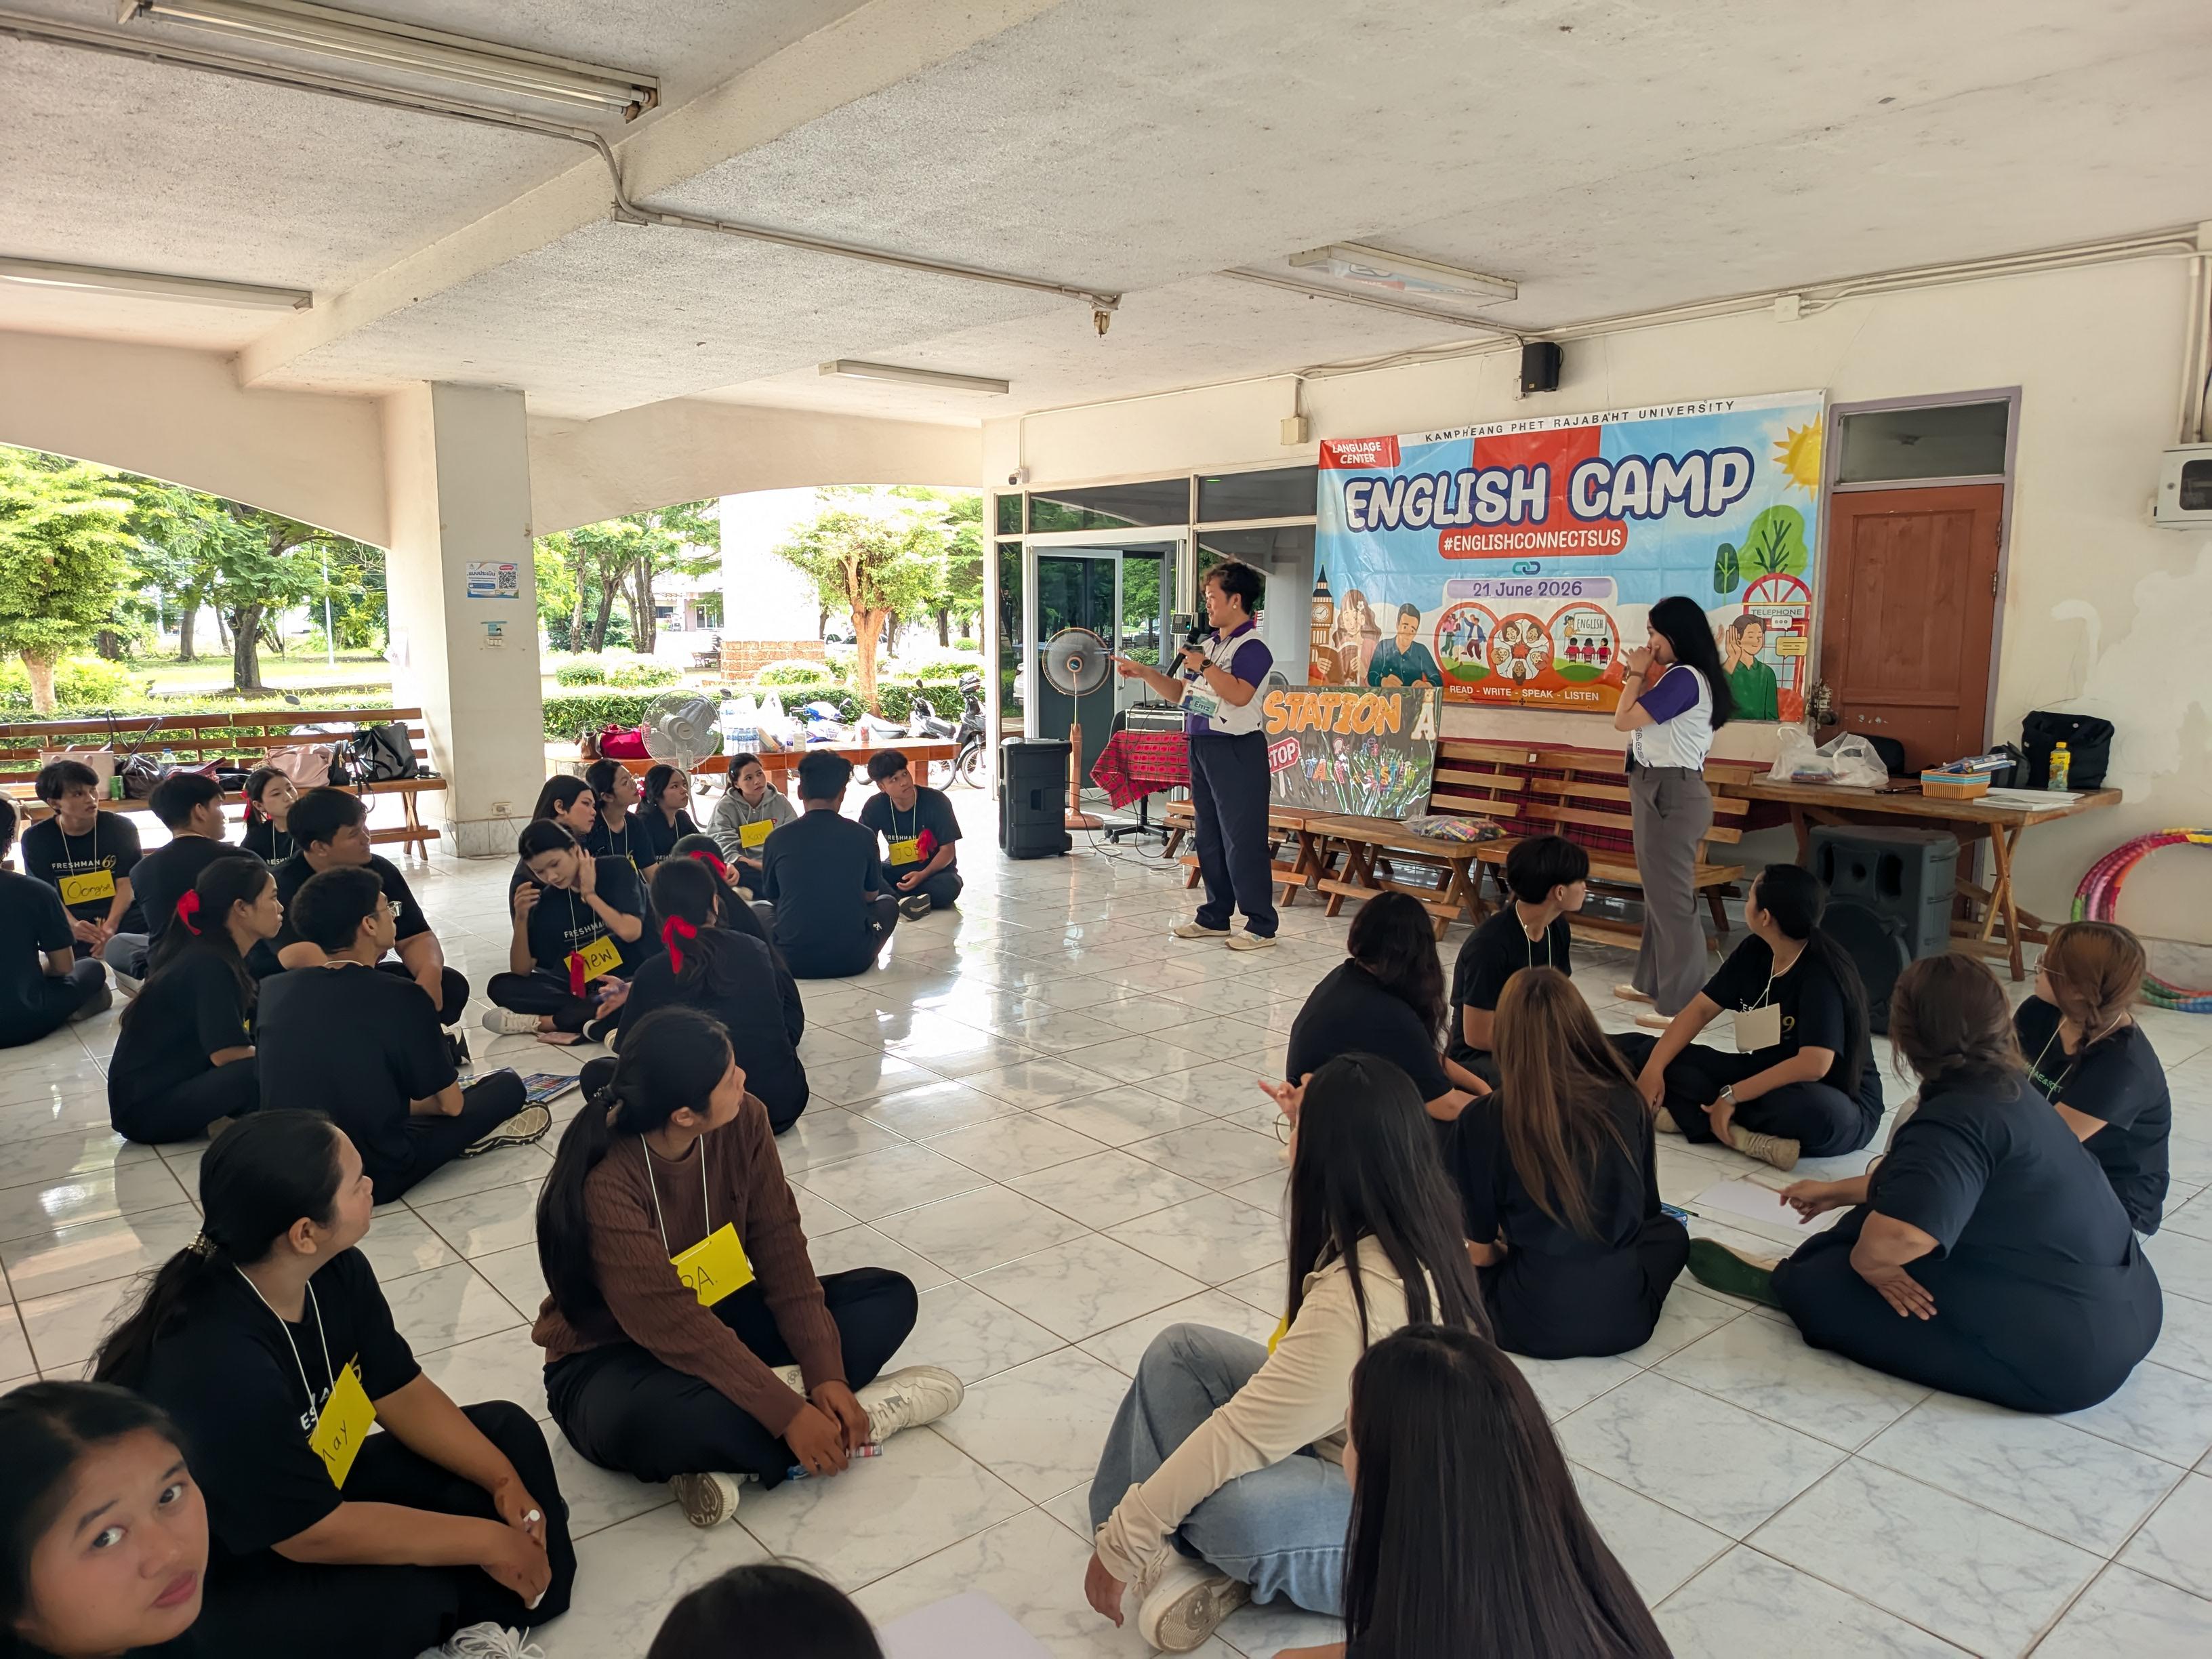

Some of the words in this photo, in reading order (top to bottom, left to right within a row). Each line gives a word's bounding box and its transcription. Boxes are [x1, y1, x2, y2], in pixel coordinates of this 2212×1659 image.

[1425, 425, 1503, 443] KAMPHEANG
[1511, 420, 1544, 432] PHET
[1553, 411, 1629, 428] RAJABAHT
[1639, 401, 1734, 419] UNIVERSITY
[1332, 441, 1382, 453] LANGUAGE
[1340, 453, 1376, 464] CENTER
[1345, 466, 1548, 530] ENGLISH
[1570, 451, 1751, 518] CAMP
[1443, 529, 1622, 552] #ENGLISHCONNECTSUS
[1473, 583, 1490, 597] 21
[1495, 582, 1533, 596] June
[1538, 581, 1582, 596] 2026
[1576, 619, 1603, 629] ENGLISH
[1450, 685, 1473, 695] READ
[1483, 687, 1511, 696] WRITE
[1522, 689, 1553, 699] SPEAK
[1564, 691, 1599, 701] LISTEN
[1193, 700, 1210, 712] Emz
[1263, 689, 1402, 737] STATION
[1410, 698, 1437, 741] A
[52, 859, 100, 869] FRESHMAN
[583, 948, 613, 971] iew
